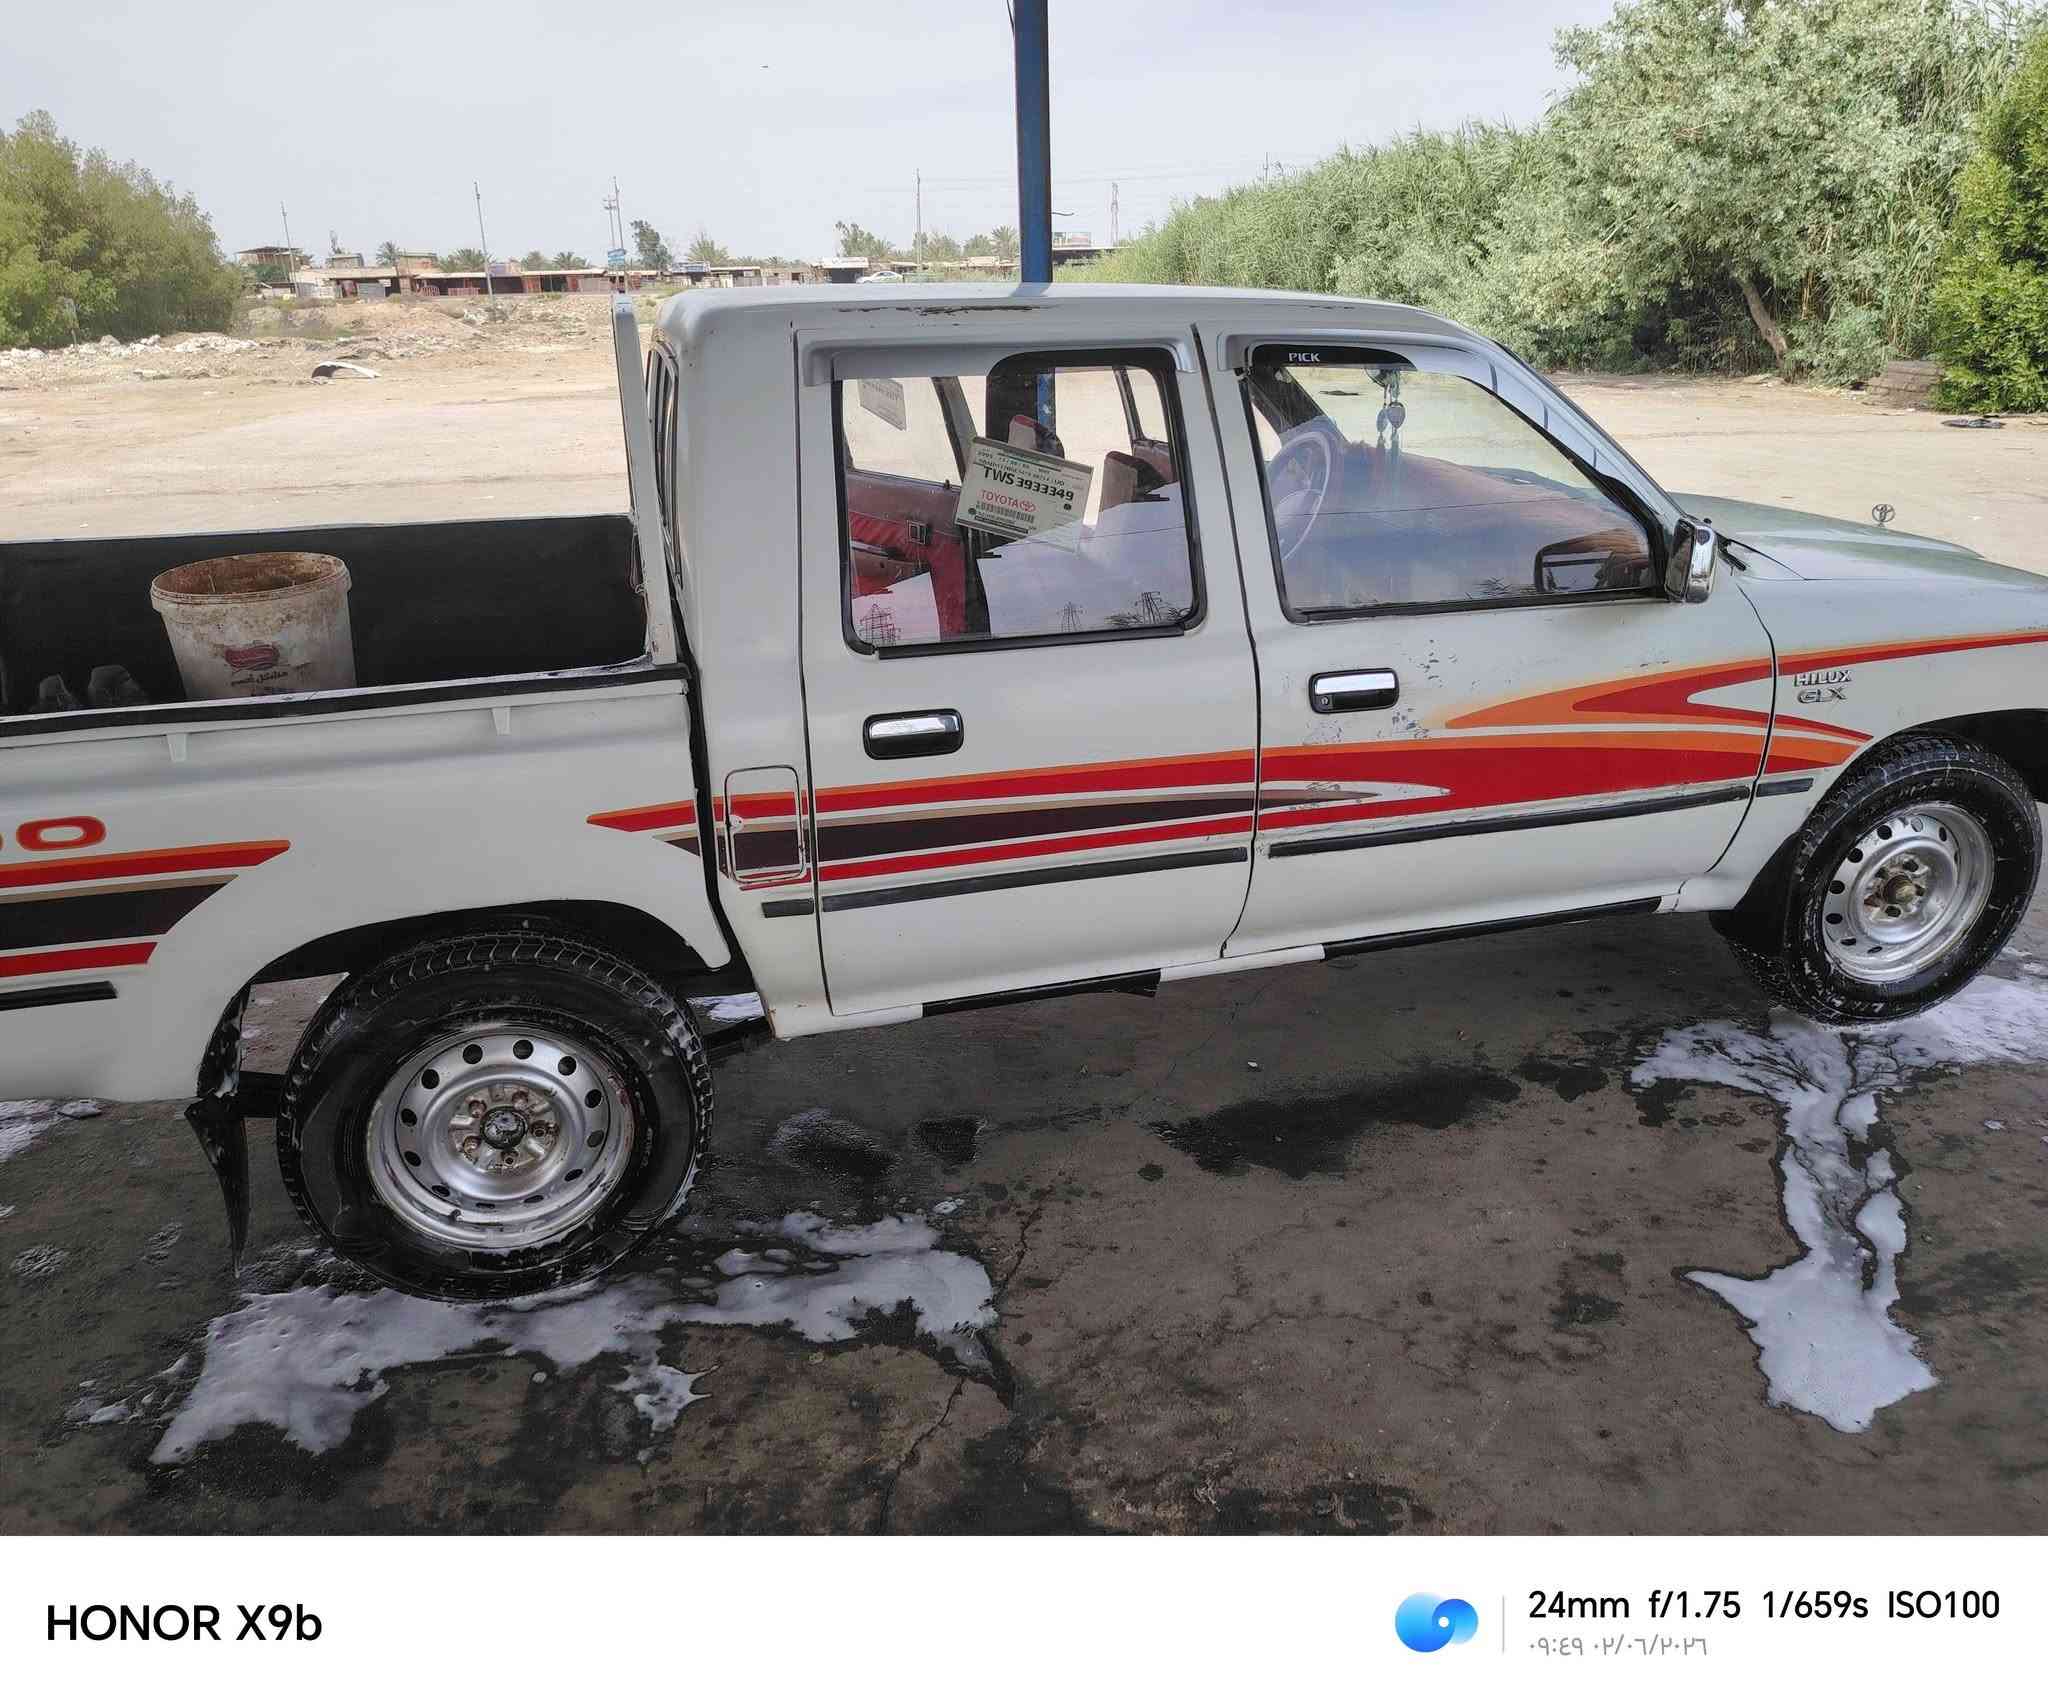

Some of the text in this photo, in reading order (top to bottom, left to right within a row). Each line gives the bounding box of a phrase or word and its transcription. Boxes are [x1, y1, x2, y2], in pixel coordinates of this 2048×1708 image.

[1288, 352, 1320, 362] PICK
[983, 466, 1015, 486] TWS
[1016, 477, 1074, 501] 3933349
[981, 490, 1019, 507] TOYOTA
[1793, 670, 1852, 687] HILUX
